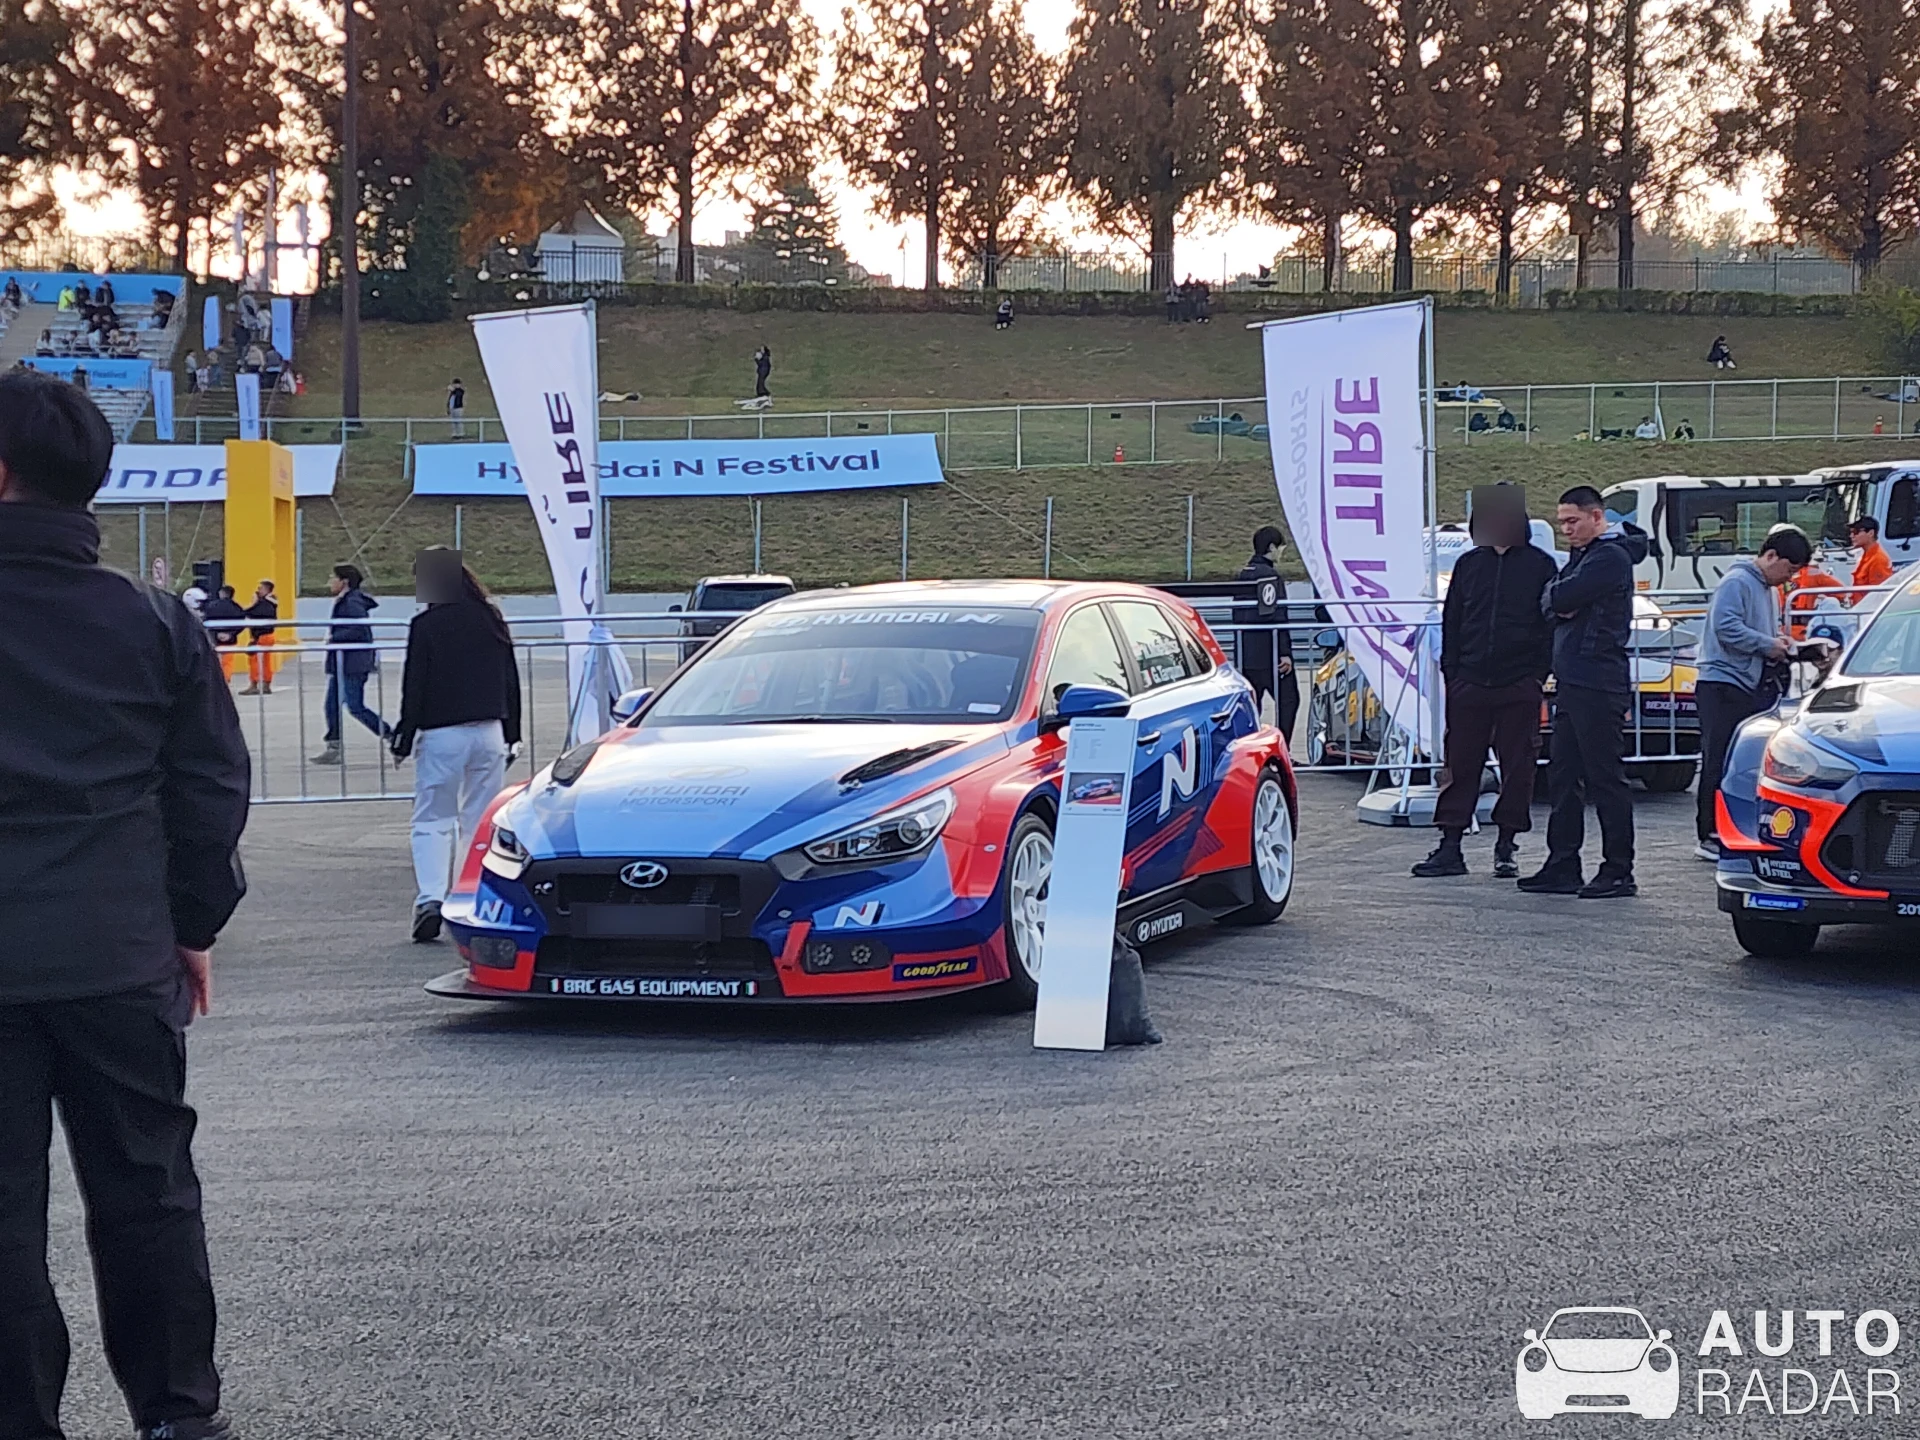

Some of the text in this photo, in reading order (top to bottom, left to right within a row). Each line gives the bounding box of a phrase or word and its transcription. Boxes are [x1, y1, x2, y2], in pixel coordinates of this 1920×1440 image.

[673, 460, 705, 477] N
[717, 450, 880, 477] Festival
[812, 612, 950, 626] HYUNDAI
[628, 785, 749, 796] HYUNDAI
[619, 797, 740, 807] MOTORSPORT
[1771, 869, 1793, 879] STEEL
[1150, 911, 1183, 937] HYUNDAI
[903, 962, 969, 977] GOODYEAR
[563, 979, 741, 996] BRC GAS EQUIPMENT
